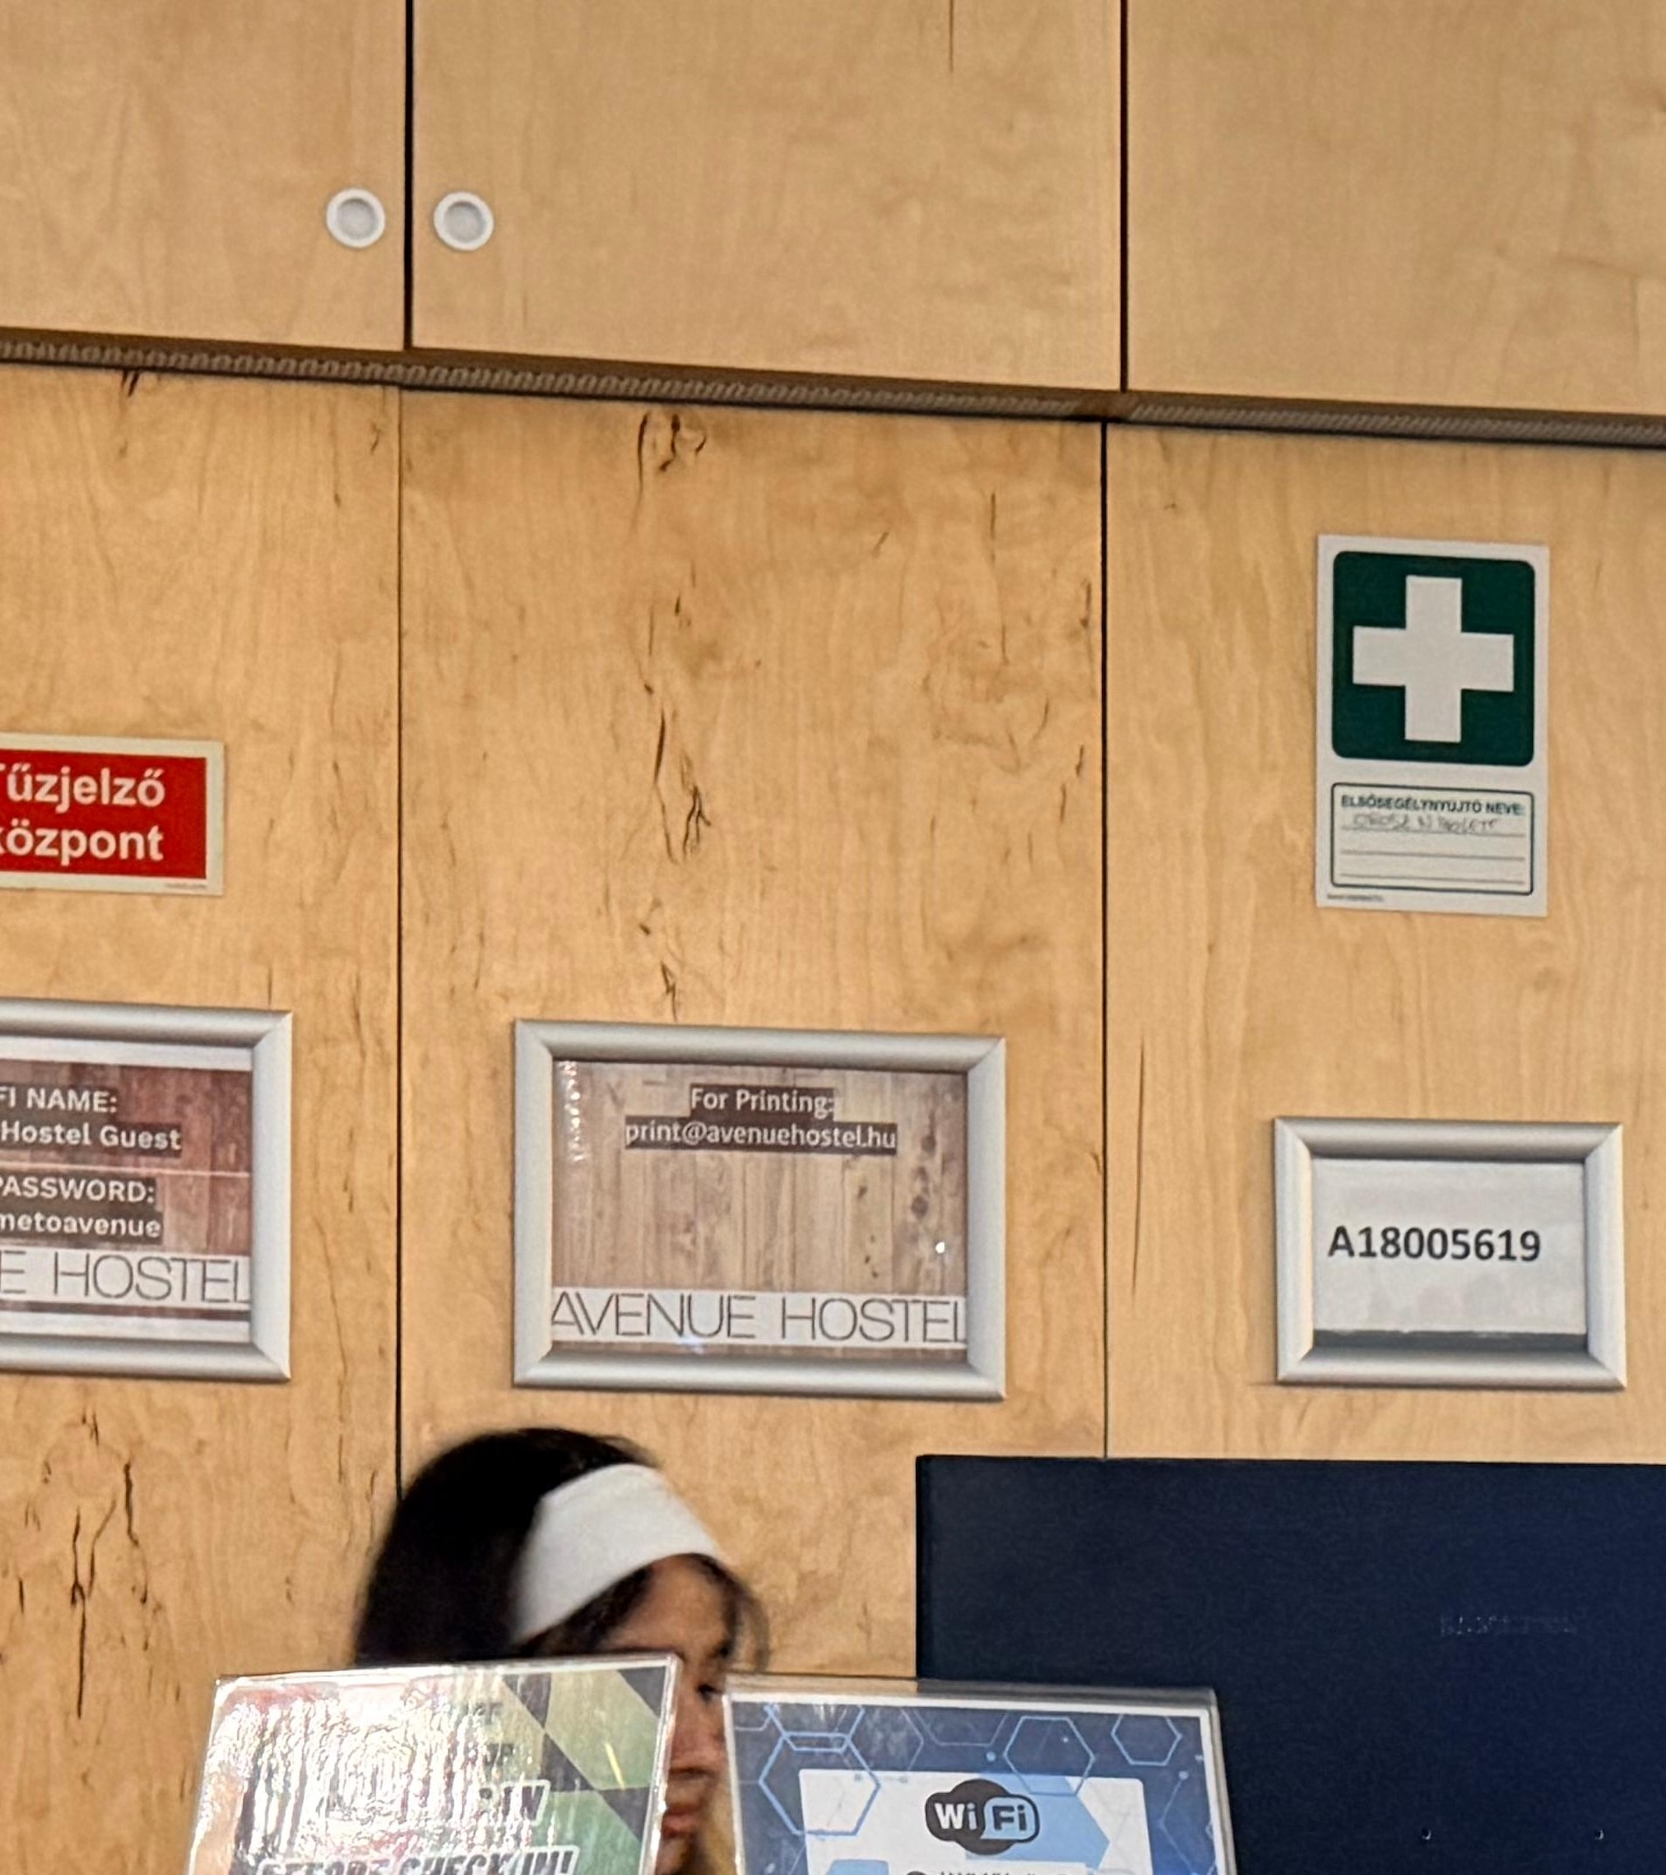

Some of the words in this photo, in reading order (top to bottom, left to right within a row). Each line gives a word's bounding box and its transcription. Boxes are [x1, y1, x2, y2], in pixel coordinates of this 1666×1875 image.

[27, 1087, 117, 1116] NAME:
[691, 1088, 728, 1110] For
[736, 1089, 836, 1117] Printing:
[1, 1119, 91, 1147] Hostel
[100, 1125, 182, 1151] Guest
[625, 1121, 897, 1151] print@avenuehostel.hu
[1328, 1225, 1541, 1262] A18005619
[53, 1251, 251, 1302] HOSTEL
[551, 1291, 756, 1340] AVENUE
